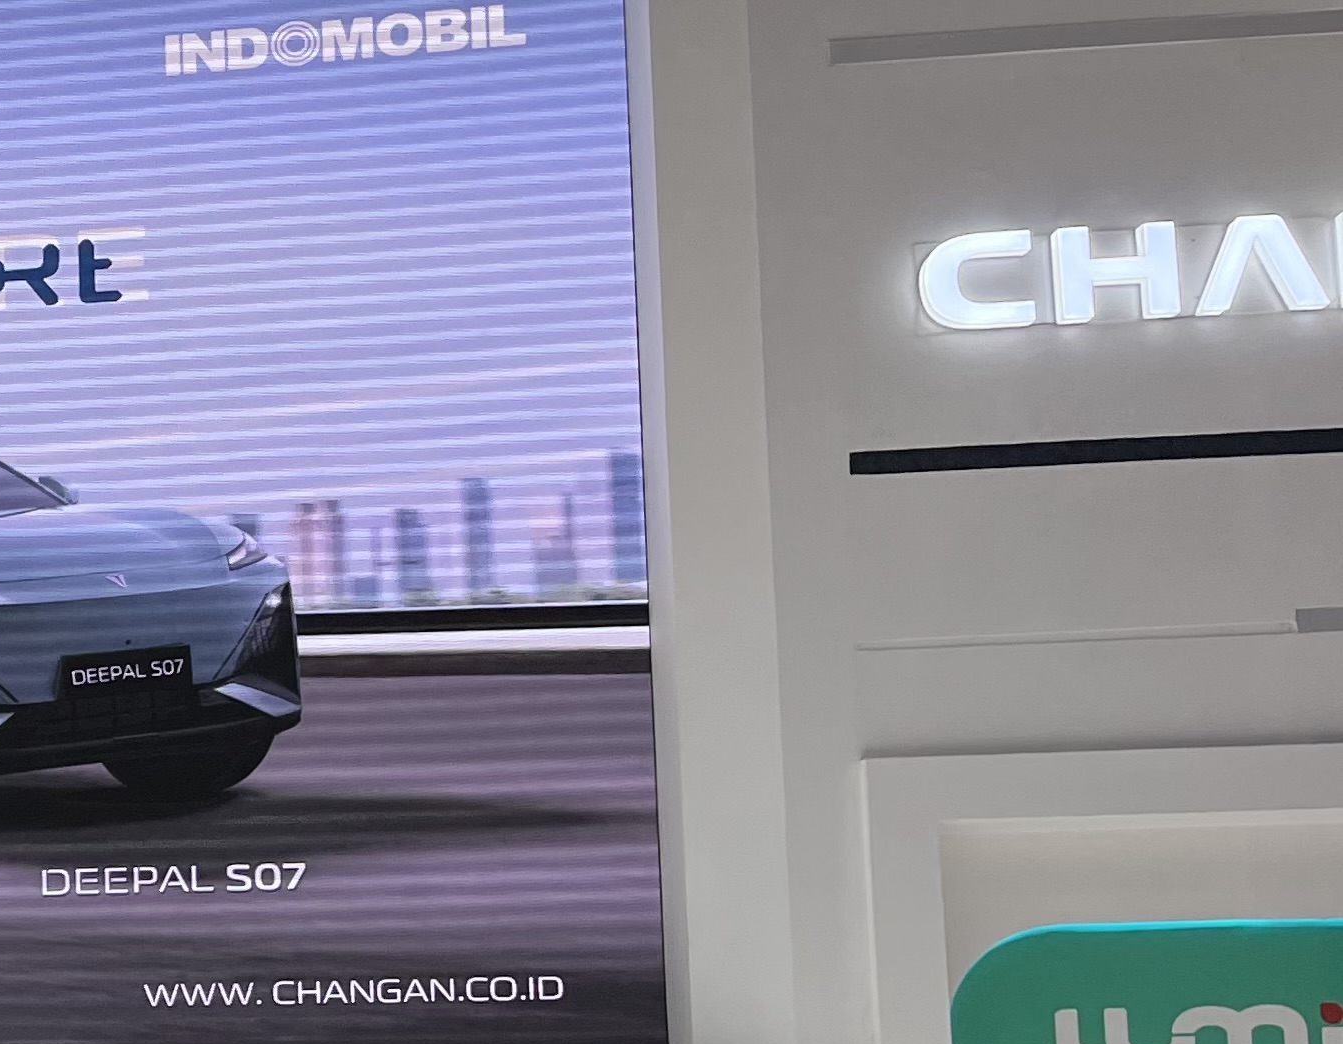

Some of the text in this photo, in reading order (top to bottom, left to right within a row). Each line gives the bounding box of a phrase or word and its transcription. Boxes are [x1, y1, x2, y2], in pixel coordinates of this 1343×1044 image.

[163, 4, 527, 77] INDOMOBIL
[917, 211, 1343, 330] CHA
[70, 657, 185, 686] DEEPAL S07
[40, 862, 307, 897] DEEPAL S07
[272, 974, 565, 1007] CHANGAN.CO.ID
